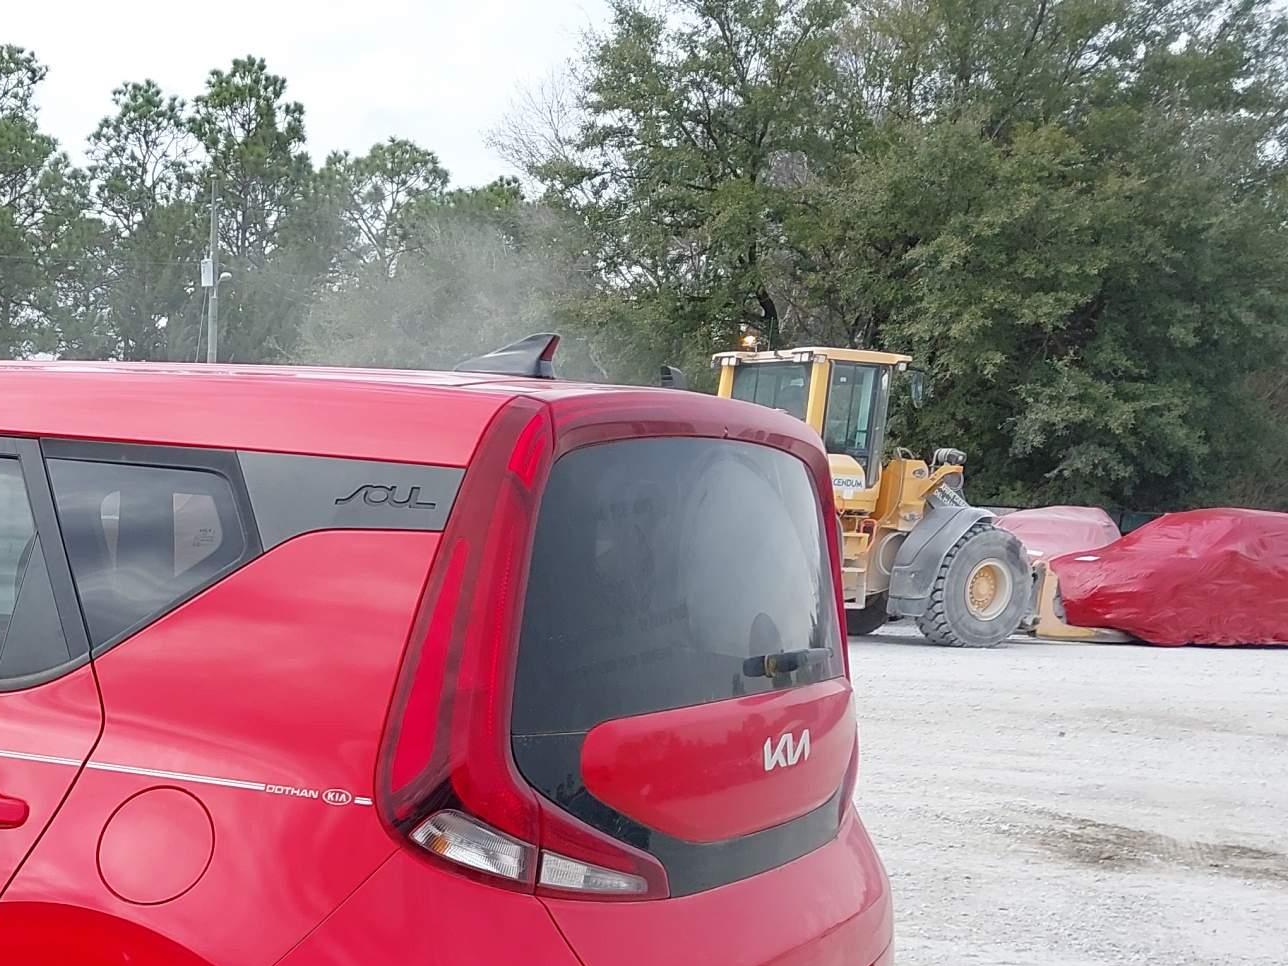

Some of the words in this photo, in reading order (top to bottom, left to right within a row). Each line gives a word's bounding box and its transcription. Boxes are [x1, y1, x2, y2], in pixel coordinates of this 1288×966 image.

[833, 478, 862, 489] CENDUM
[334, 484, 437, 510] SOUL
[763, 728, 811, 772] KIA
[265, 783, 319, 799] DOTHAN
[326, 790, 348, 803] KIA
